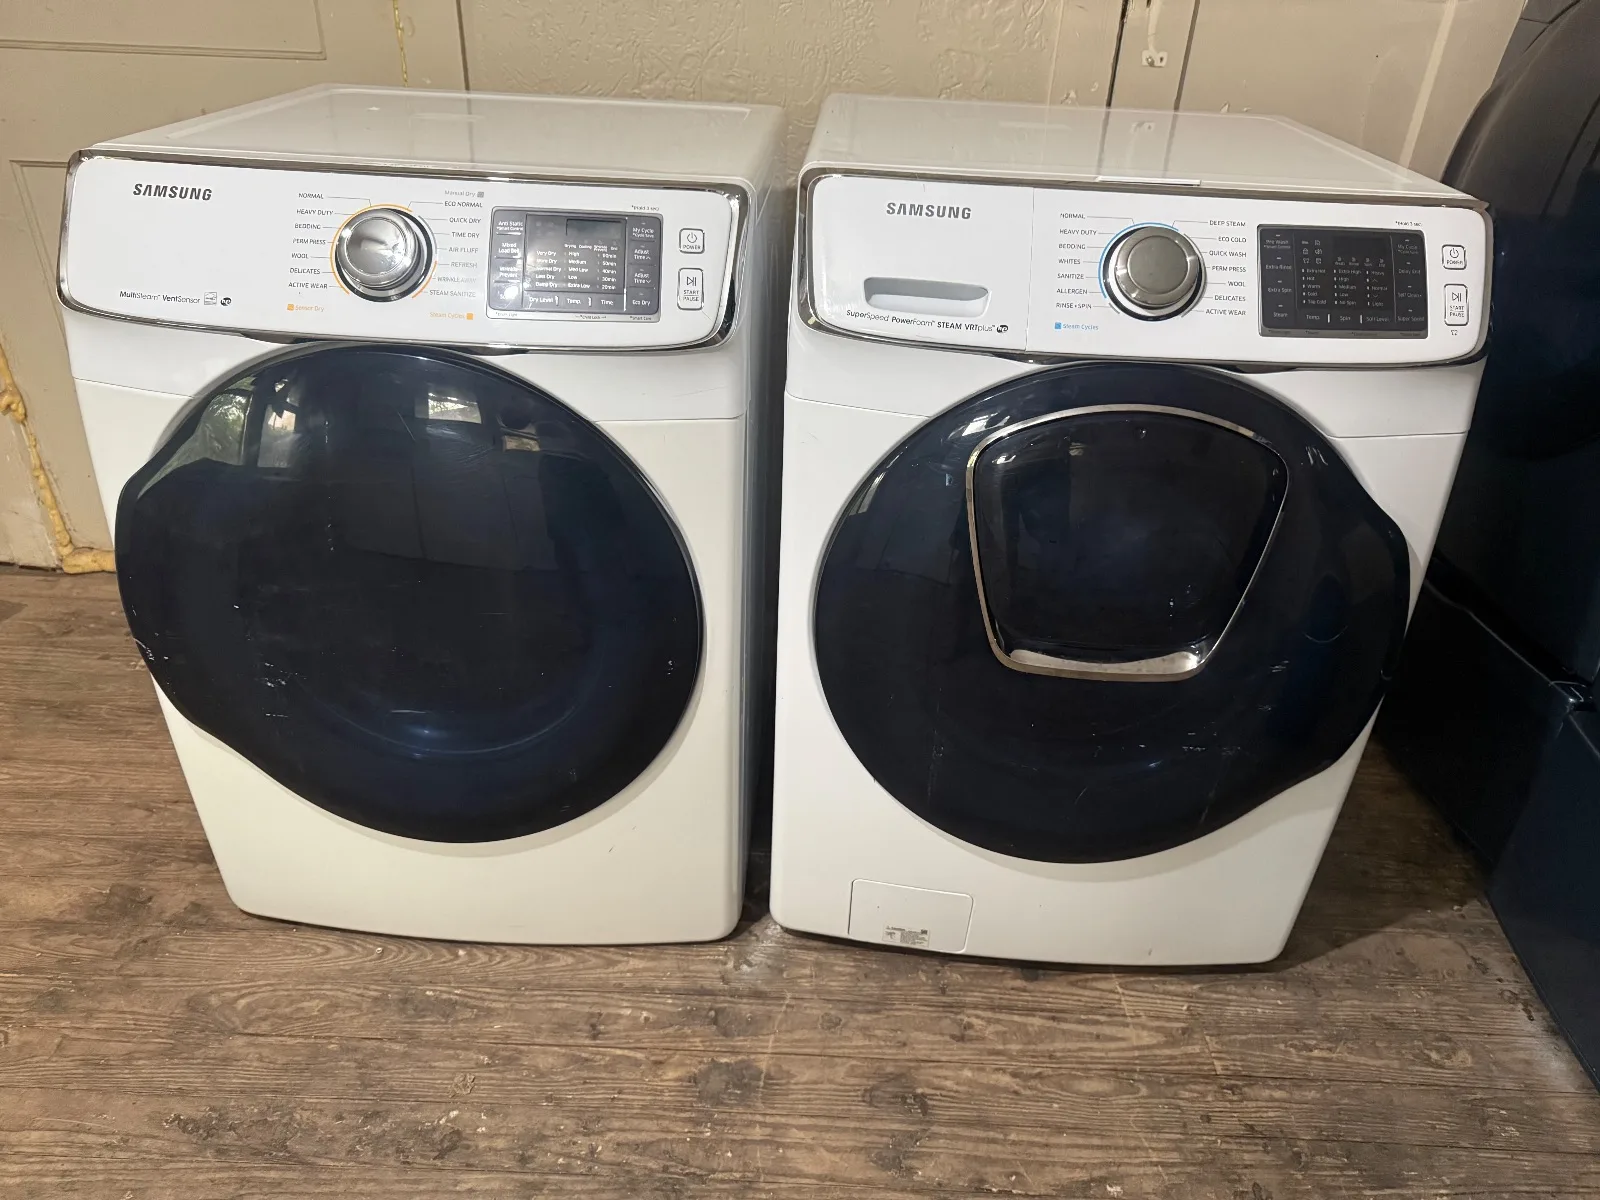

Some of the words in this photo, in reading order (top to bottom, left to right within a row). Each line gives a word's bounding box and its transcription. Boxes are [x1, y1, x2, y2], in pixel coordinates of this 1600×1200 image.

[133, 184, 212, 200] SAMSUNG
[887, 202, 972, 219] SAMSUNG
[846, 310, 889, 322] SuperSpeed
[937, 322, 962, 330] STEAM
